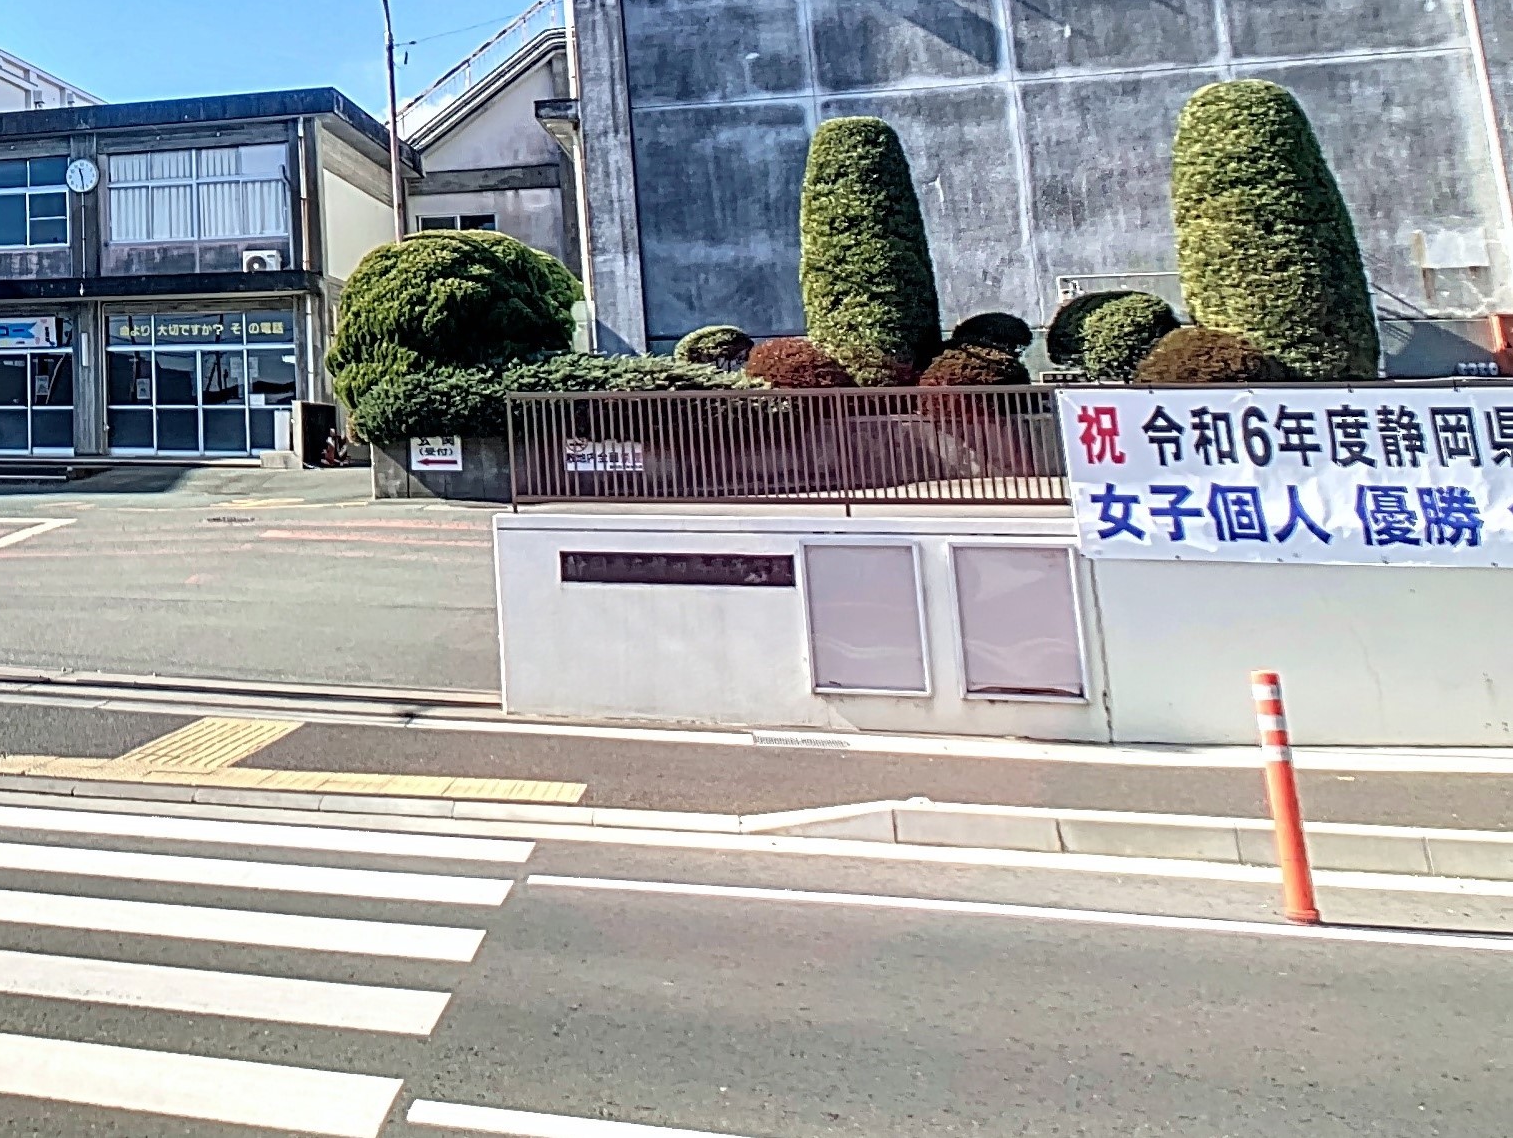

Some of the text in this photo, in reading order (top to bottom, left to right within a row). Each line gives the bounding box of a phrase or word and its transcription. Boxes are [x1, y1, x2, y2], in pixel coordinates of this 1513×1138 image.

[1077, 405, 1126, 464] 祝
[1089, 482, 1485, 548] 女子個人 優勝
